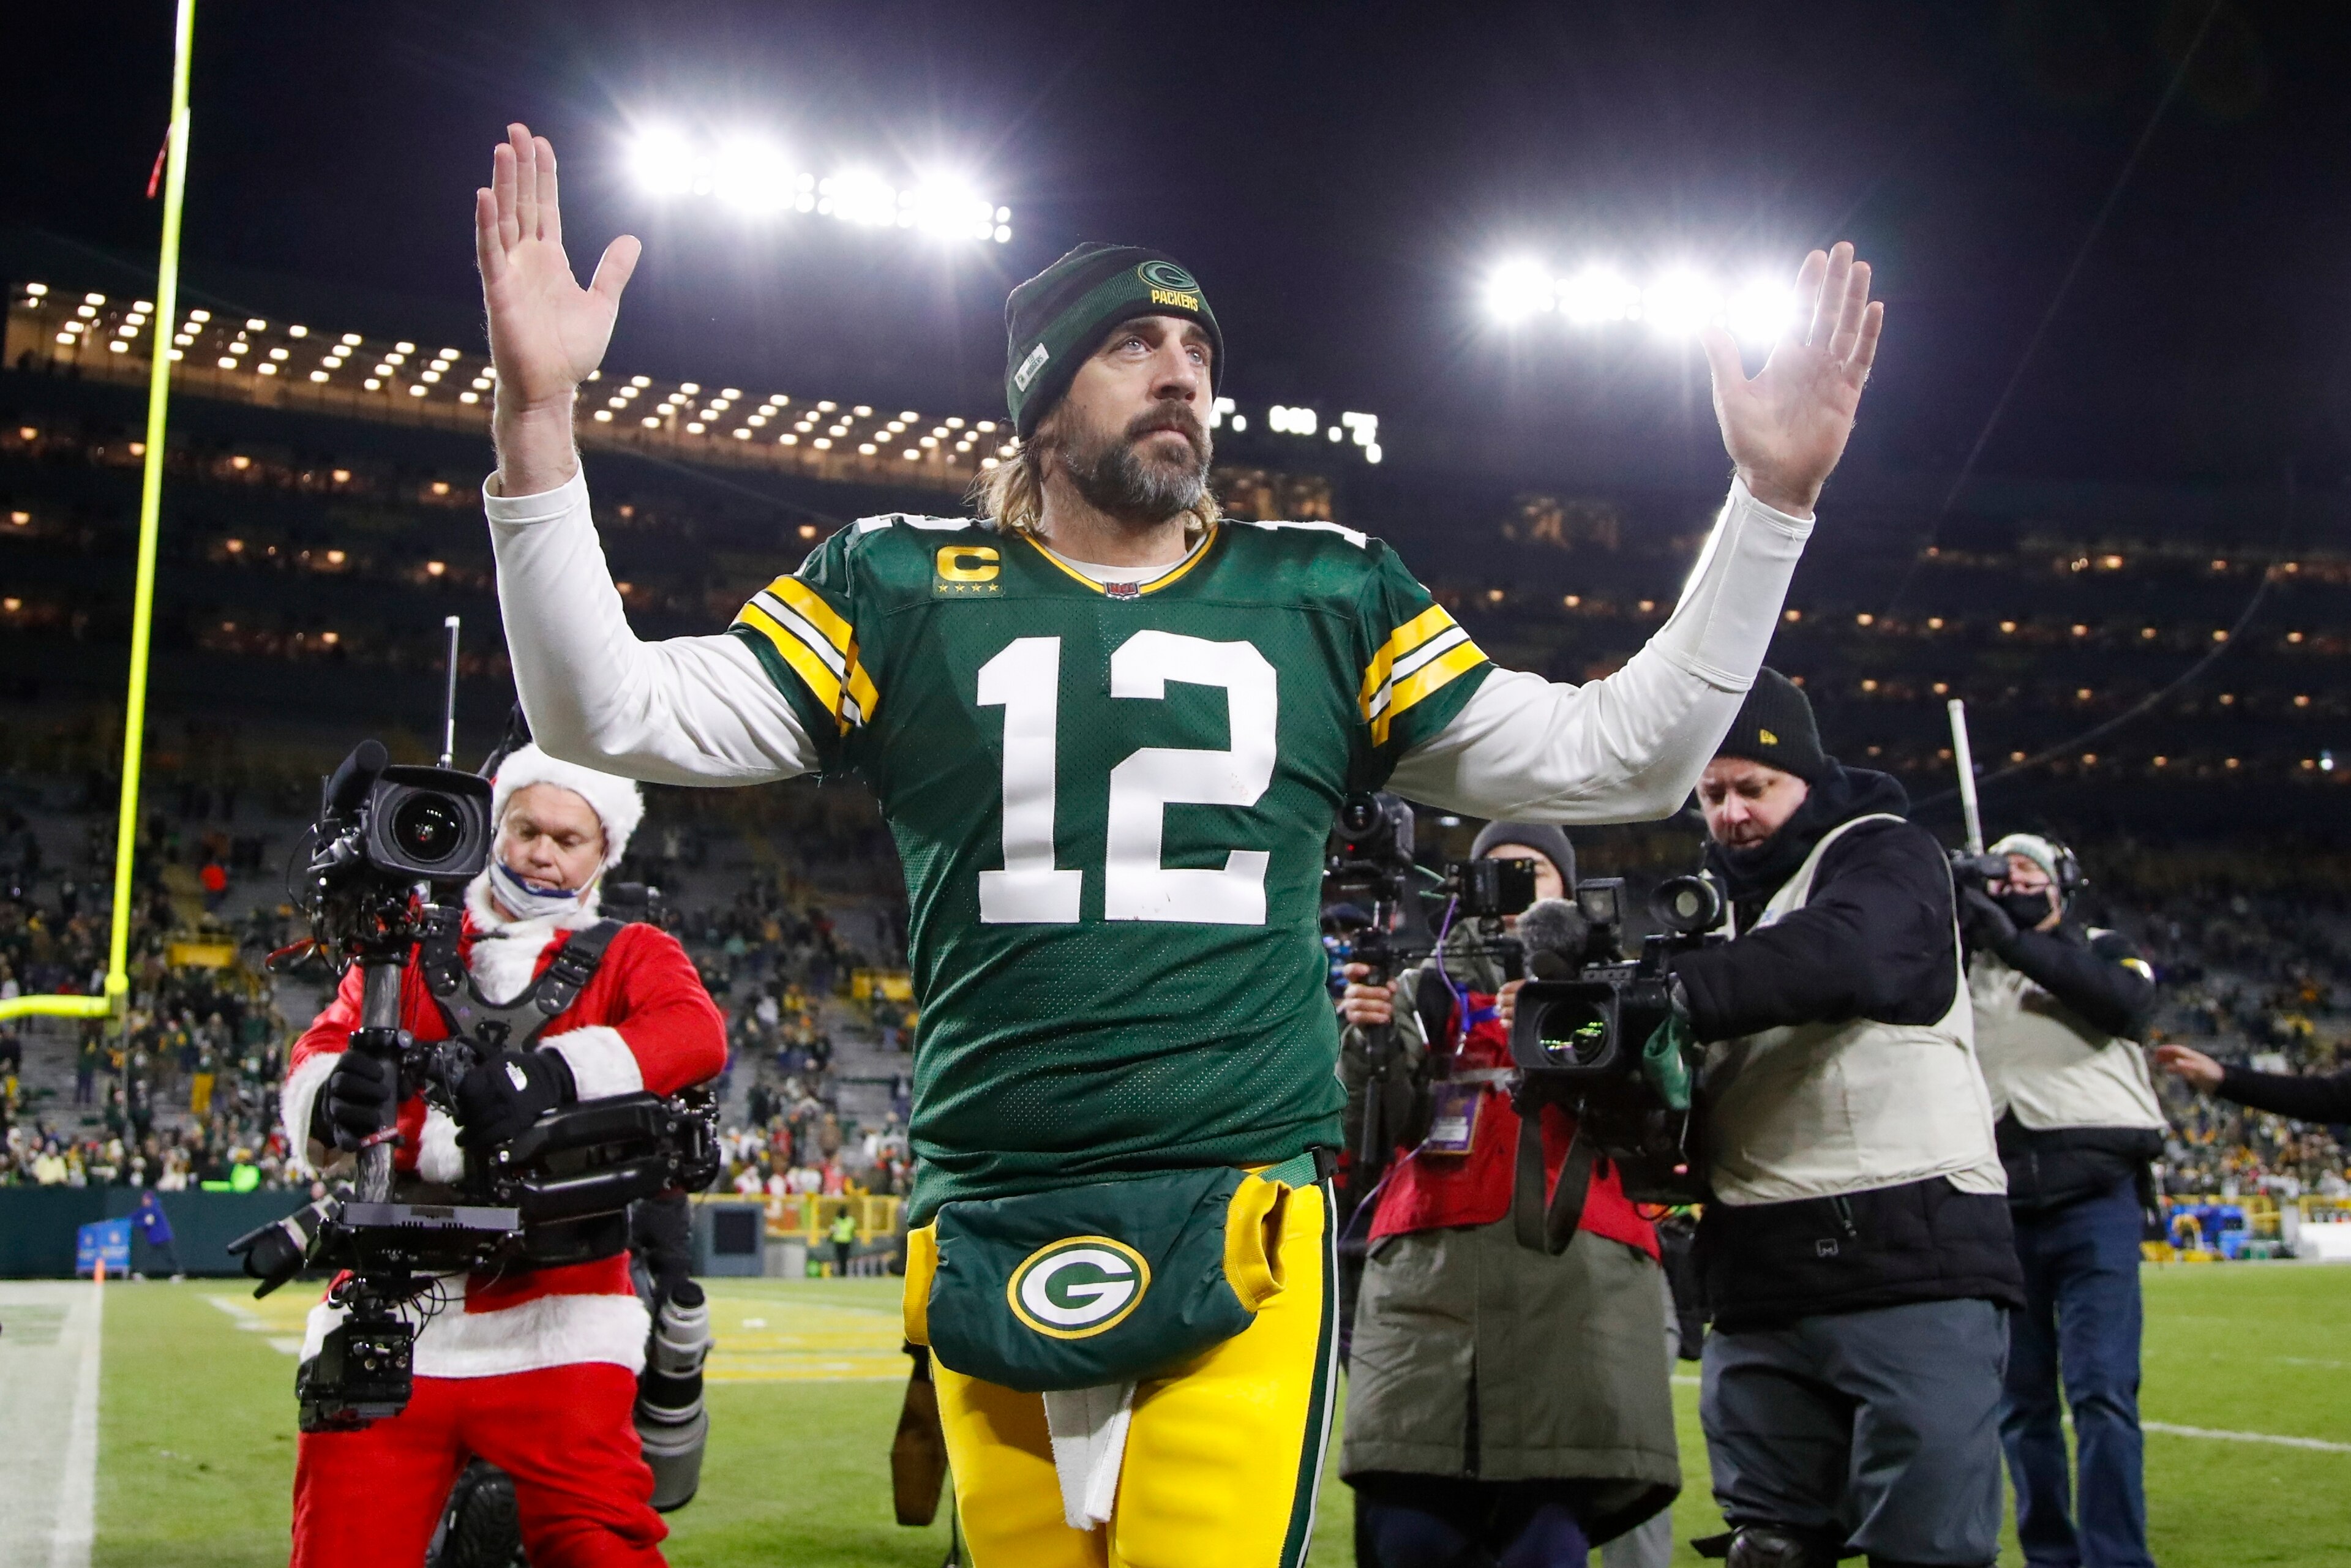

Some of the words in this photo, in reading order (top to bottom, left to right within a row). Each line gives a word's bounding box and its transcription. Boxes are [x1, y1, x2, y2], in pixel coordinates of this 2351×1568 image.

[1143, 261, 1196, 289] G
[1151, 290, 1199, 312] PACKERS
[937, 546, 1000, 582] C
[1109, 583, 1135, 594] NFL
[977, 629, 1278, 925] 12
[1021, 1249, 1135, 1325] G
